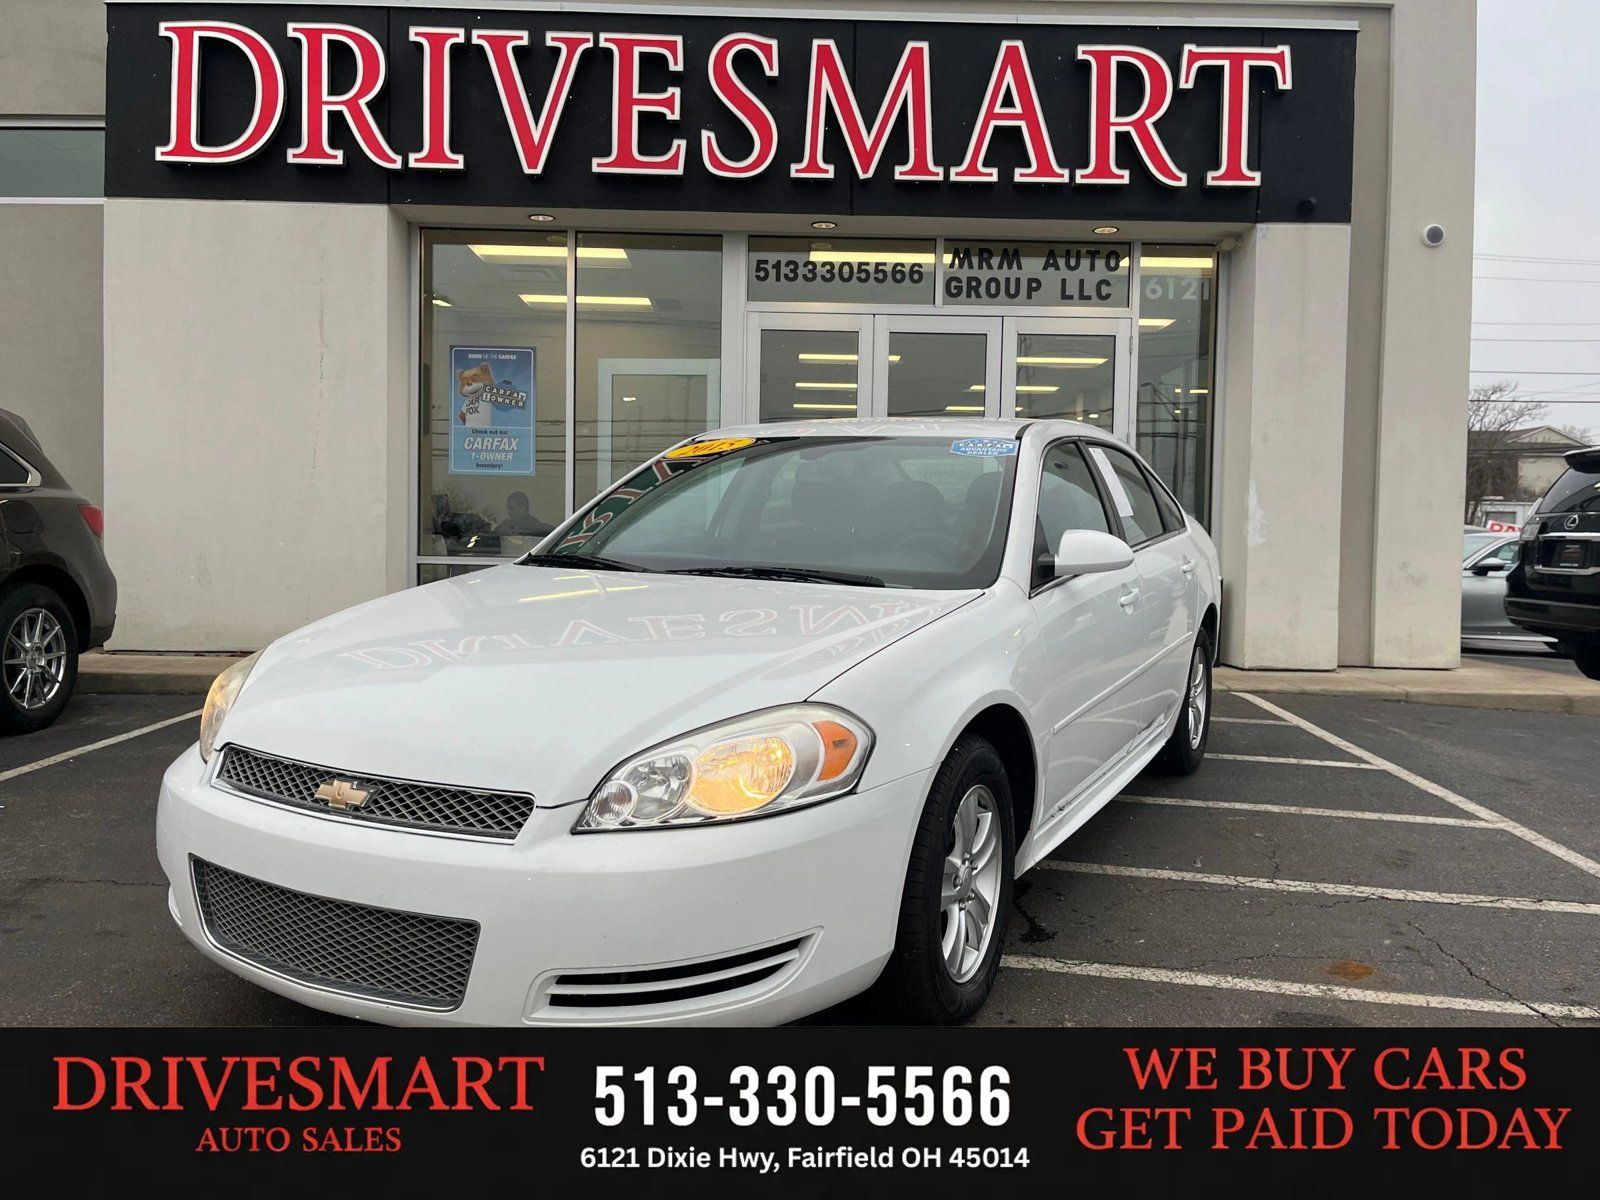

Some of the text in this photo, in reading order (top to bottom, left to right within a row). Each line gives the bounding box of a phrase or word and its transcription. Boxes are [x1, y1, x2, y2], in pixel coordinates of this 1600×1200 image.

[154, 20, 1293, 188] DRIVESMART
[948, 247, 1121, 272] MRM AUTO
[754, 259, 924, 284] 5133305566
[945, 276, 1112, 301] GROUP LLC
[484, 385, 527, 401] CARFAX
[491, 395, 524, 408] OWNER
[464, 436, 520, 451] CARFAX
[471, 451, 513, 461] 1-OWNER
